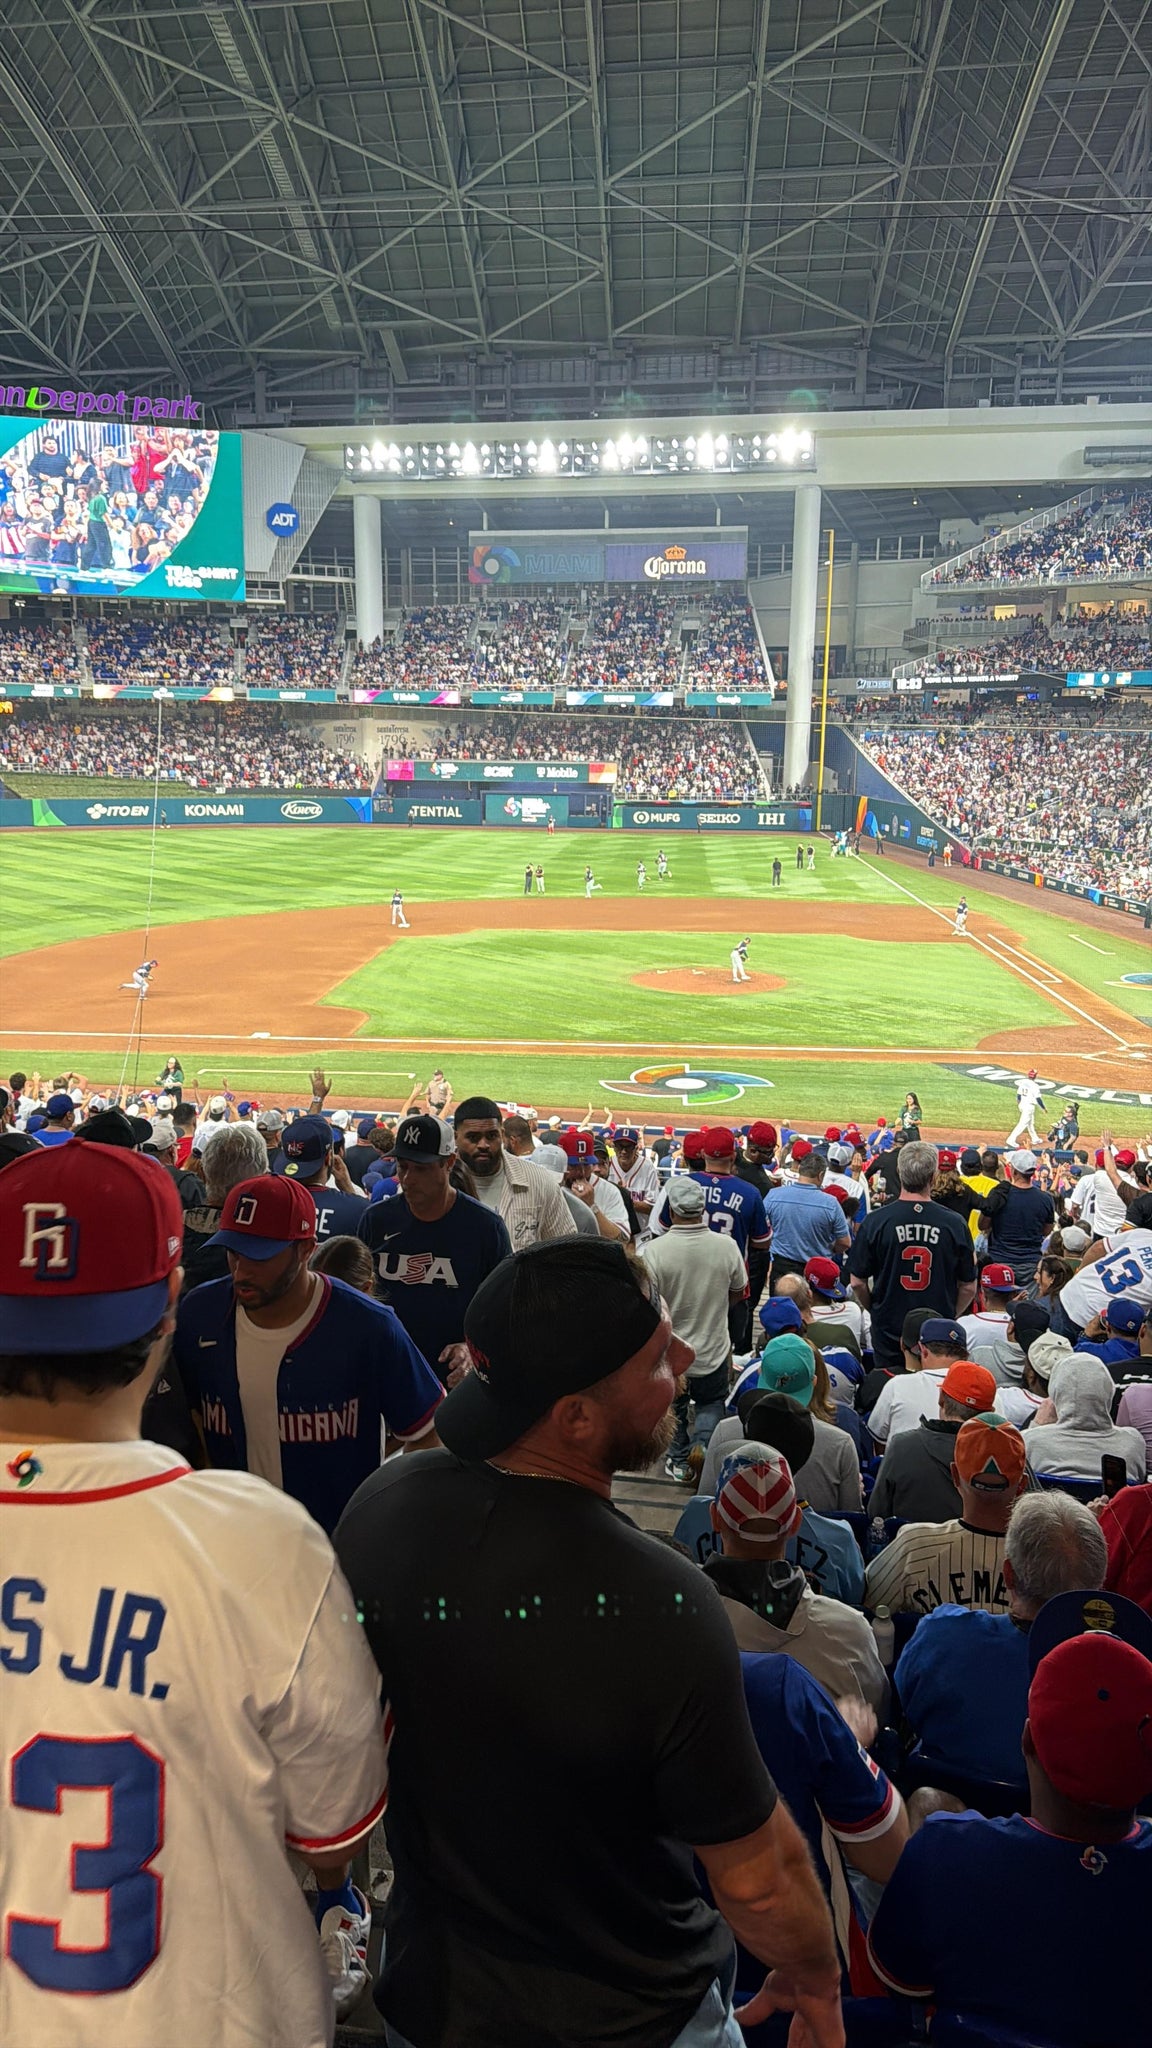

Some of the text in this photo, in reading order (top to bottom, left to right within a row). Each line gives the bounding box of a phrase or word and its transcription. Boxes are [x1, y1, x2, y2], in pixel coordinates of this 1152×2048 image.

[0, 385, 200, 422] nDepot park
[272, 513, 297, 527] ADT
[525, 554, 600, 576] MIAMI
[644, 556, 706, 580] Corona
[335, 733, 355, 748] 1796
[380, 733, 407, 748] 1796
[106, 805, 150, 817] ITO EN
[184, 804, 244, 816] KONAMI
[284, 803, 321, 816] Kowa
[411, 805, 463, 818] TENTIAL
[650, 813, 681, 823] MUFG
[698, 813, 741, 823] SEIKO
[758, 813, 786, 825] IHI
[578, 1140, 587, 1154] D
[723, 1191, 744, 1213] JR.
[895, 1223, 940, 1245] BETTS
[378, 1252, 459, 1287] USA
[900, 1245, 933, 1291] 3
[1094, 1246, 1144, 1295] 13
[59, 1586, 170, 1700] JR.
[7, 1732, 166, 1996] 3
